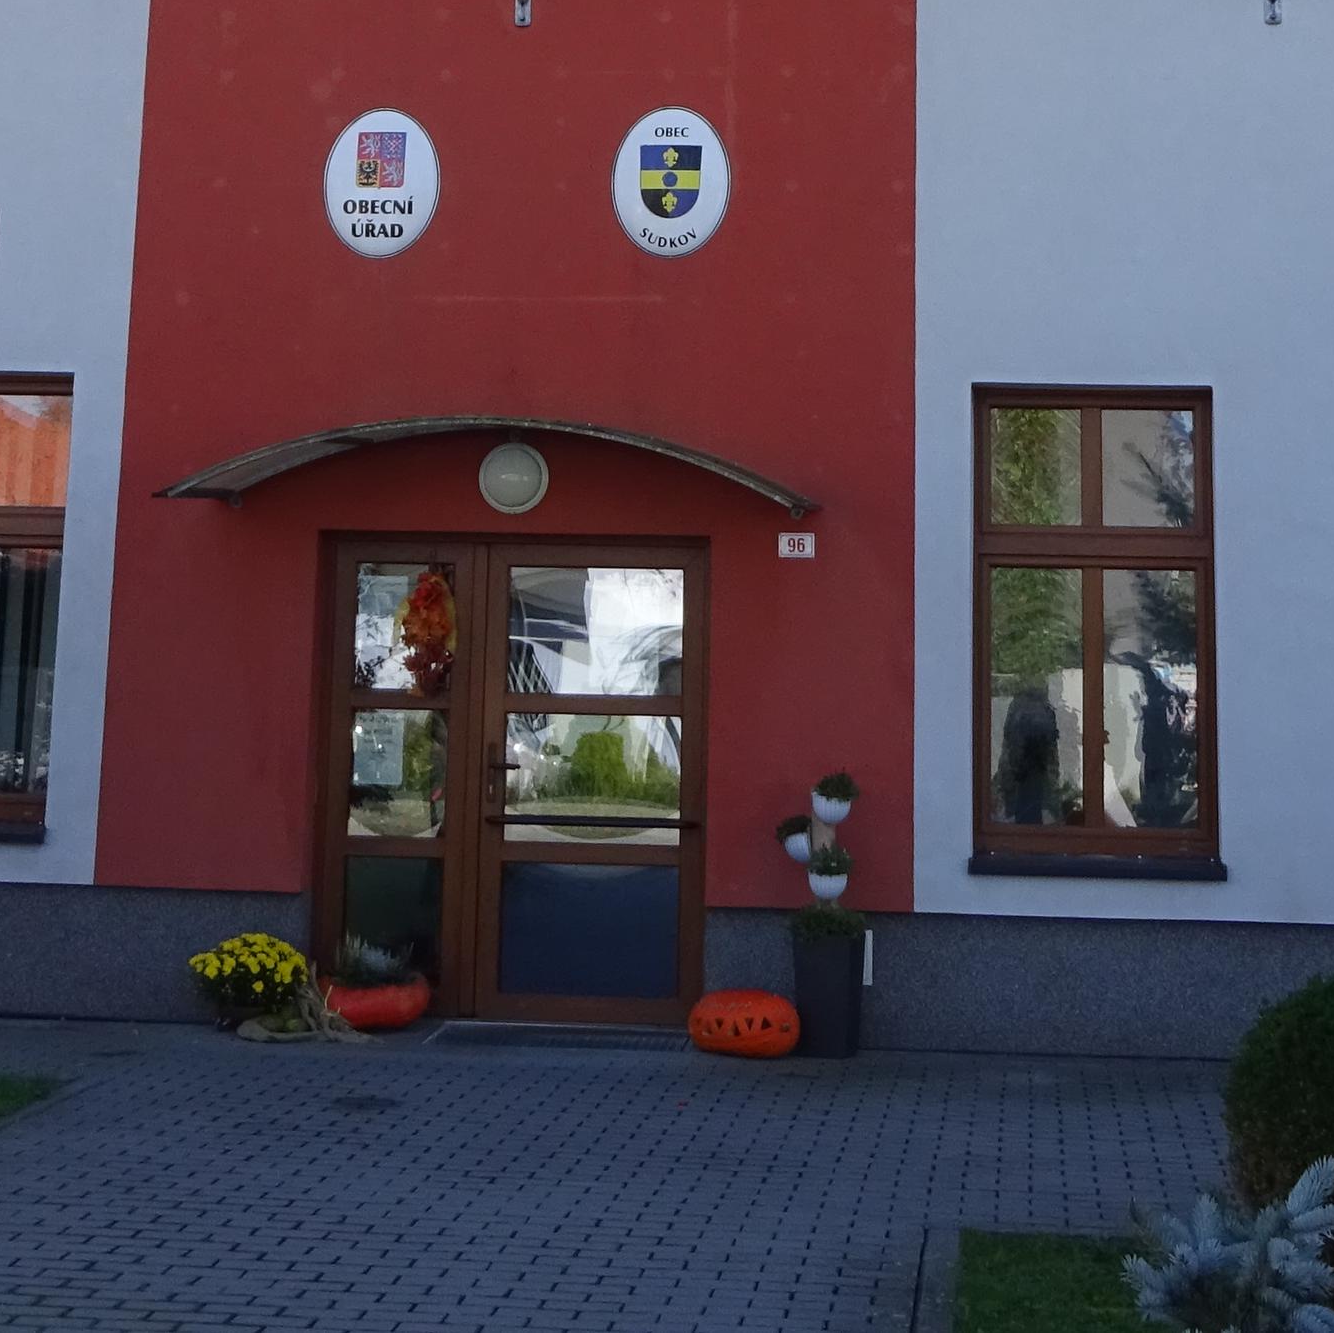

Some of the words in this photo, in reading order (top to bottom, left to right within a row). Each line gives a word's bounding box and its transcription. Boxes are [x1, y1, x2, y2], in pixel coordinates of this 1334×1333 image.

[654, 127, 689, 138] OBEC
[343, 196, 413, 214] OBECNÍ
[351, 218, 404, 238] ÚŘAD
[639, 227, 697, 248] SUDKOV
[787, 537, 805, 553] 96
